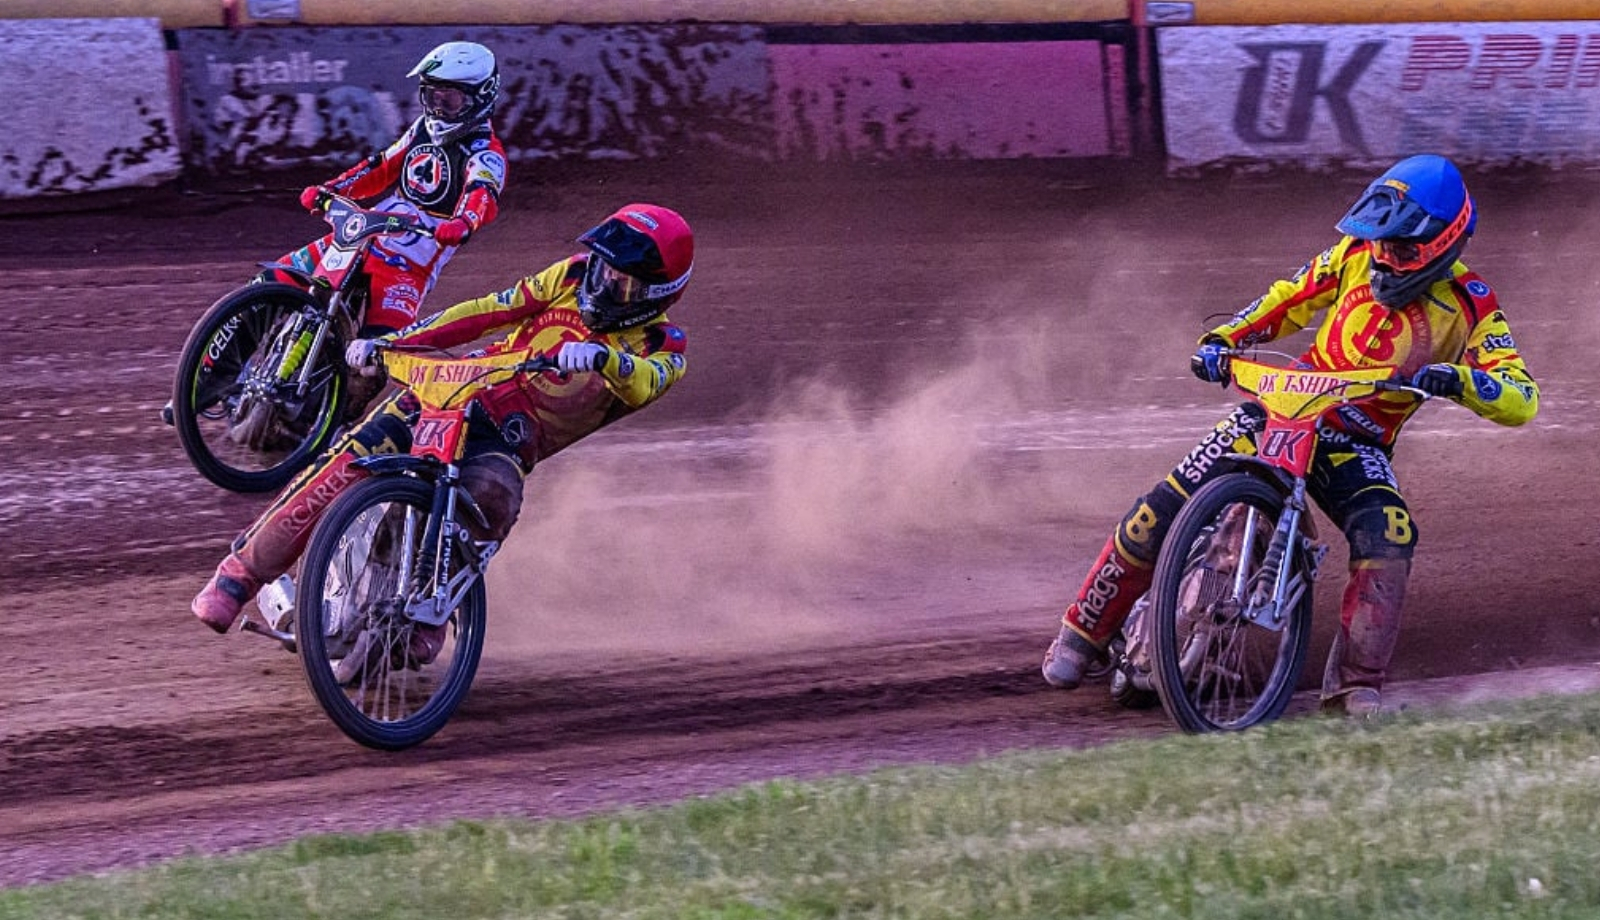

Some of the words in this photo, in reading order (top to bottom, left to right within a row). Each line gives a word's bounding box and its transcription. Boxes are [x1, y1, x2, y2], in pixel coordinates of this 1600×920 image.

[206, 52, 347, 85] installer
[1351, 303, 1404, 362] B
[1258, 374, 1279, 393] OK
[1185, 415, 1256, 483] SHOCKS
[1126, 502, 1158, 544] B
[1382, 505, 1413, 546] B
